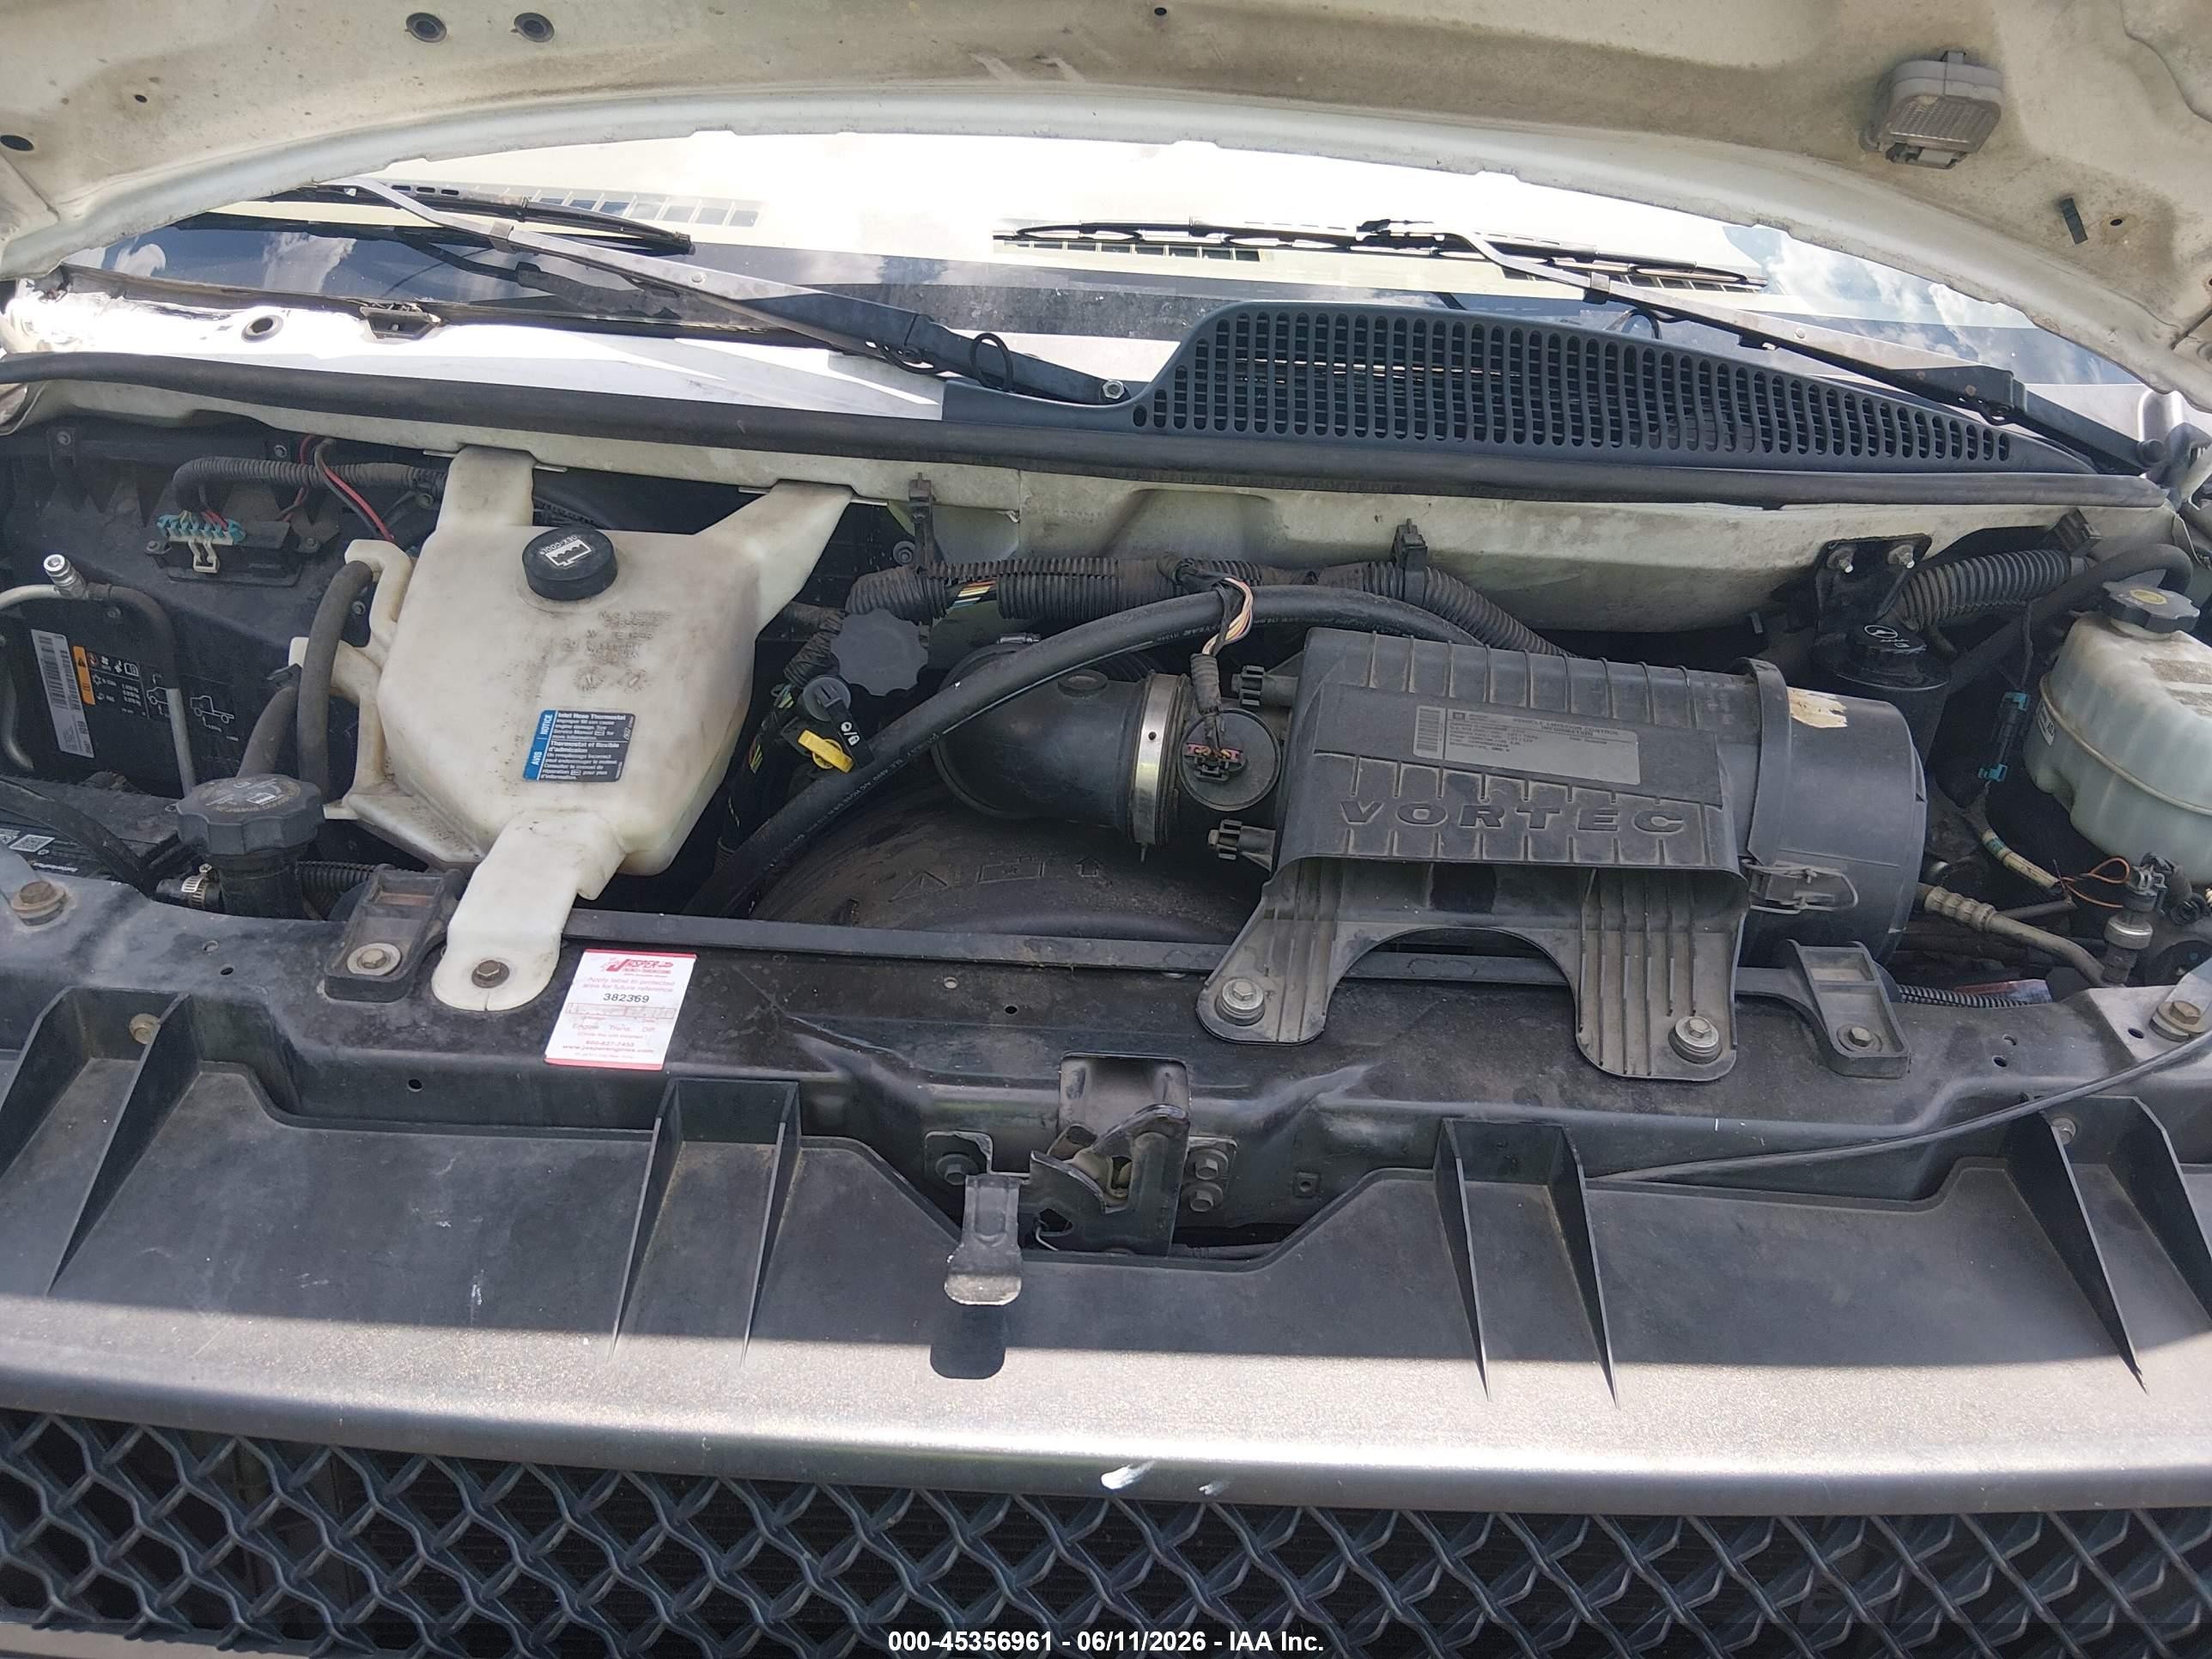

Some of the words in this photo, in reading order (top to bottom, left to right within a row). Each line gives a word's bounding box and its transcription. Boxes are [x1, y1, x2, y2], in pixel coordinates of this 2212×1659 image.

[540, 714, 554, 735] NOTICE
[532, 751, 543, 765] AVIS
[1339, 799, 1685, 834] VORTEC
[603, 993, 650, 1003] 382369
